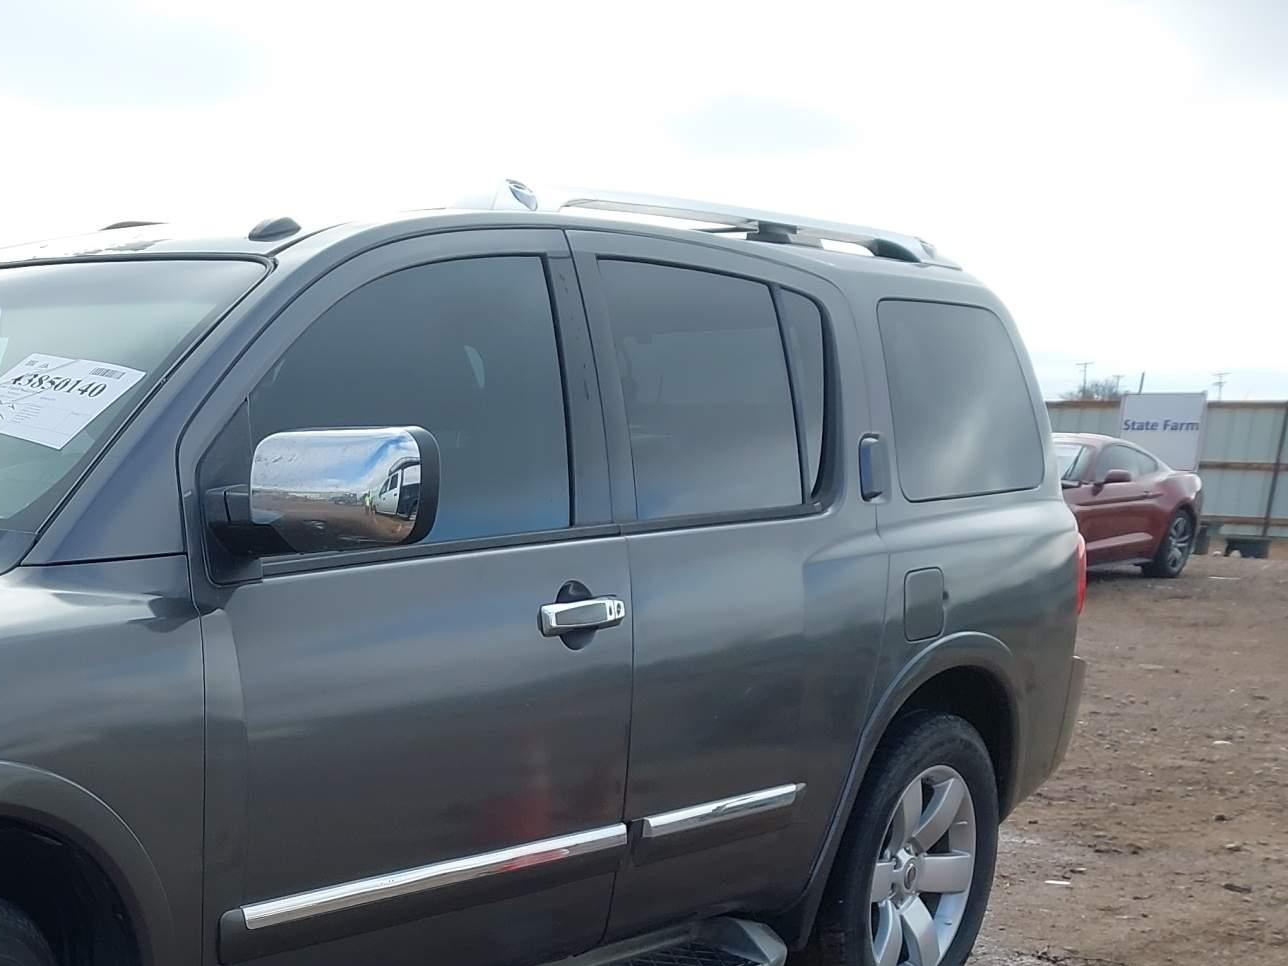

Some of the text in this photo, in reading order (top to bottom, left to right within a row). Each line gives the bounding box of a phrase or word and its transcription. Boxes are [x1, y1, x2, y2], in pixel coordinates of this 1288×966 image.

[10, 372, 108, 398] 43850140
[1122, 419, 1200, 431] State Farm
